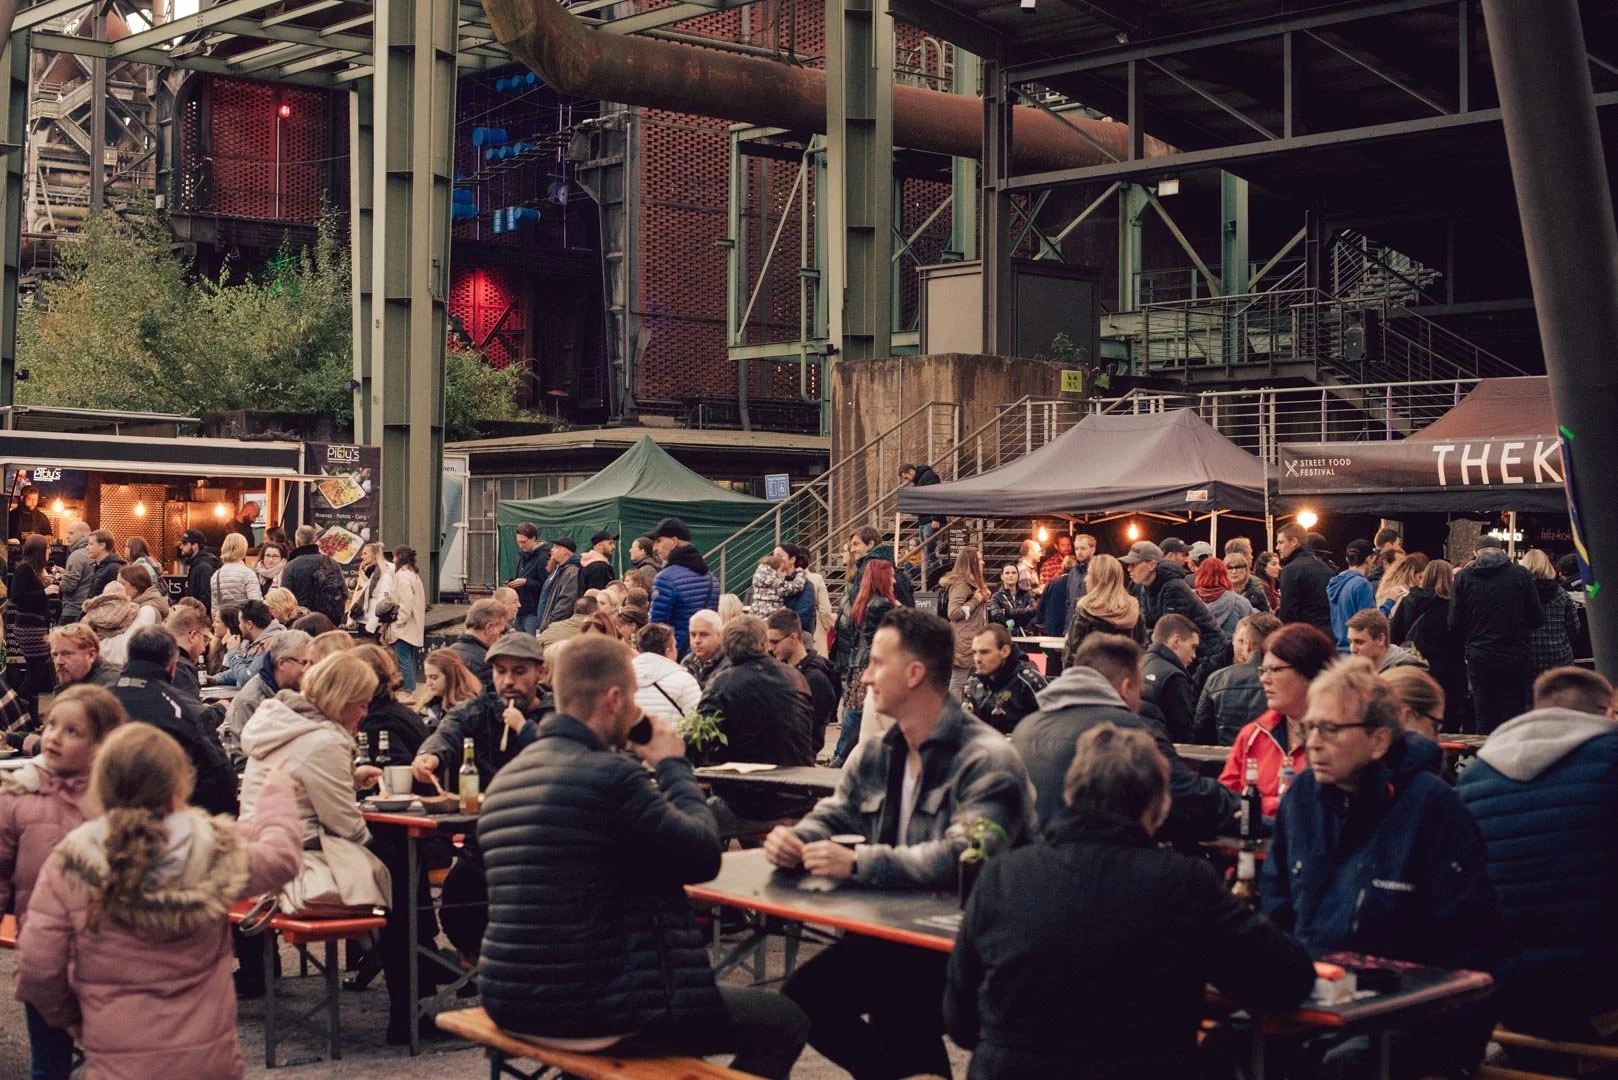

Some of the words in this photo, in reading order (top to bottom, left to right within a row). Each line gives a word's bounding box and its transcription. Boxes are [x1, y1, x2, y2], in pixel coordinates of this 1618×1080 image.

[1300, 459, 1326, 467] STREET
[1328, 458, 1351, 466] FOOD
[1432, 441, 1563, 485] THEK
[1300, 468, 1335, 476] FESTIVAL
